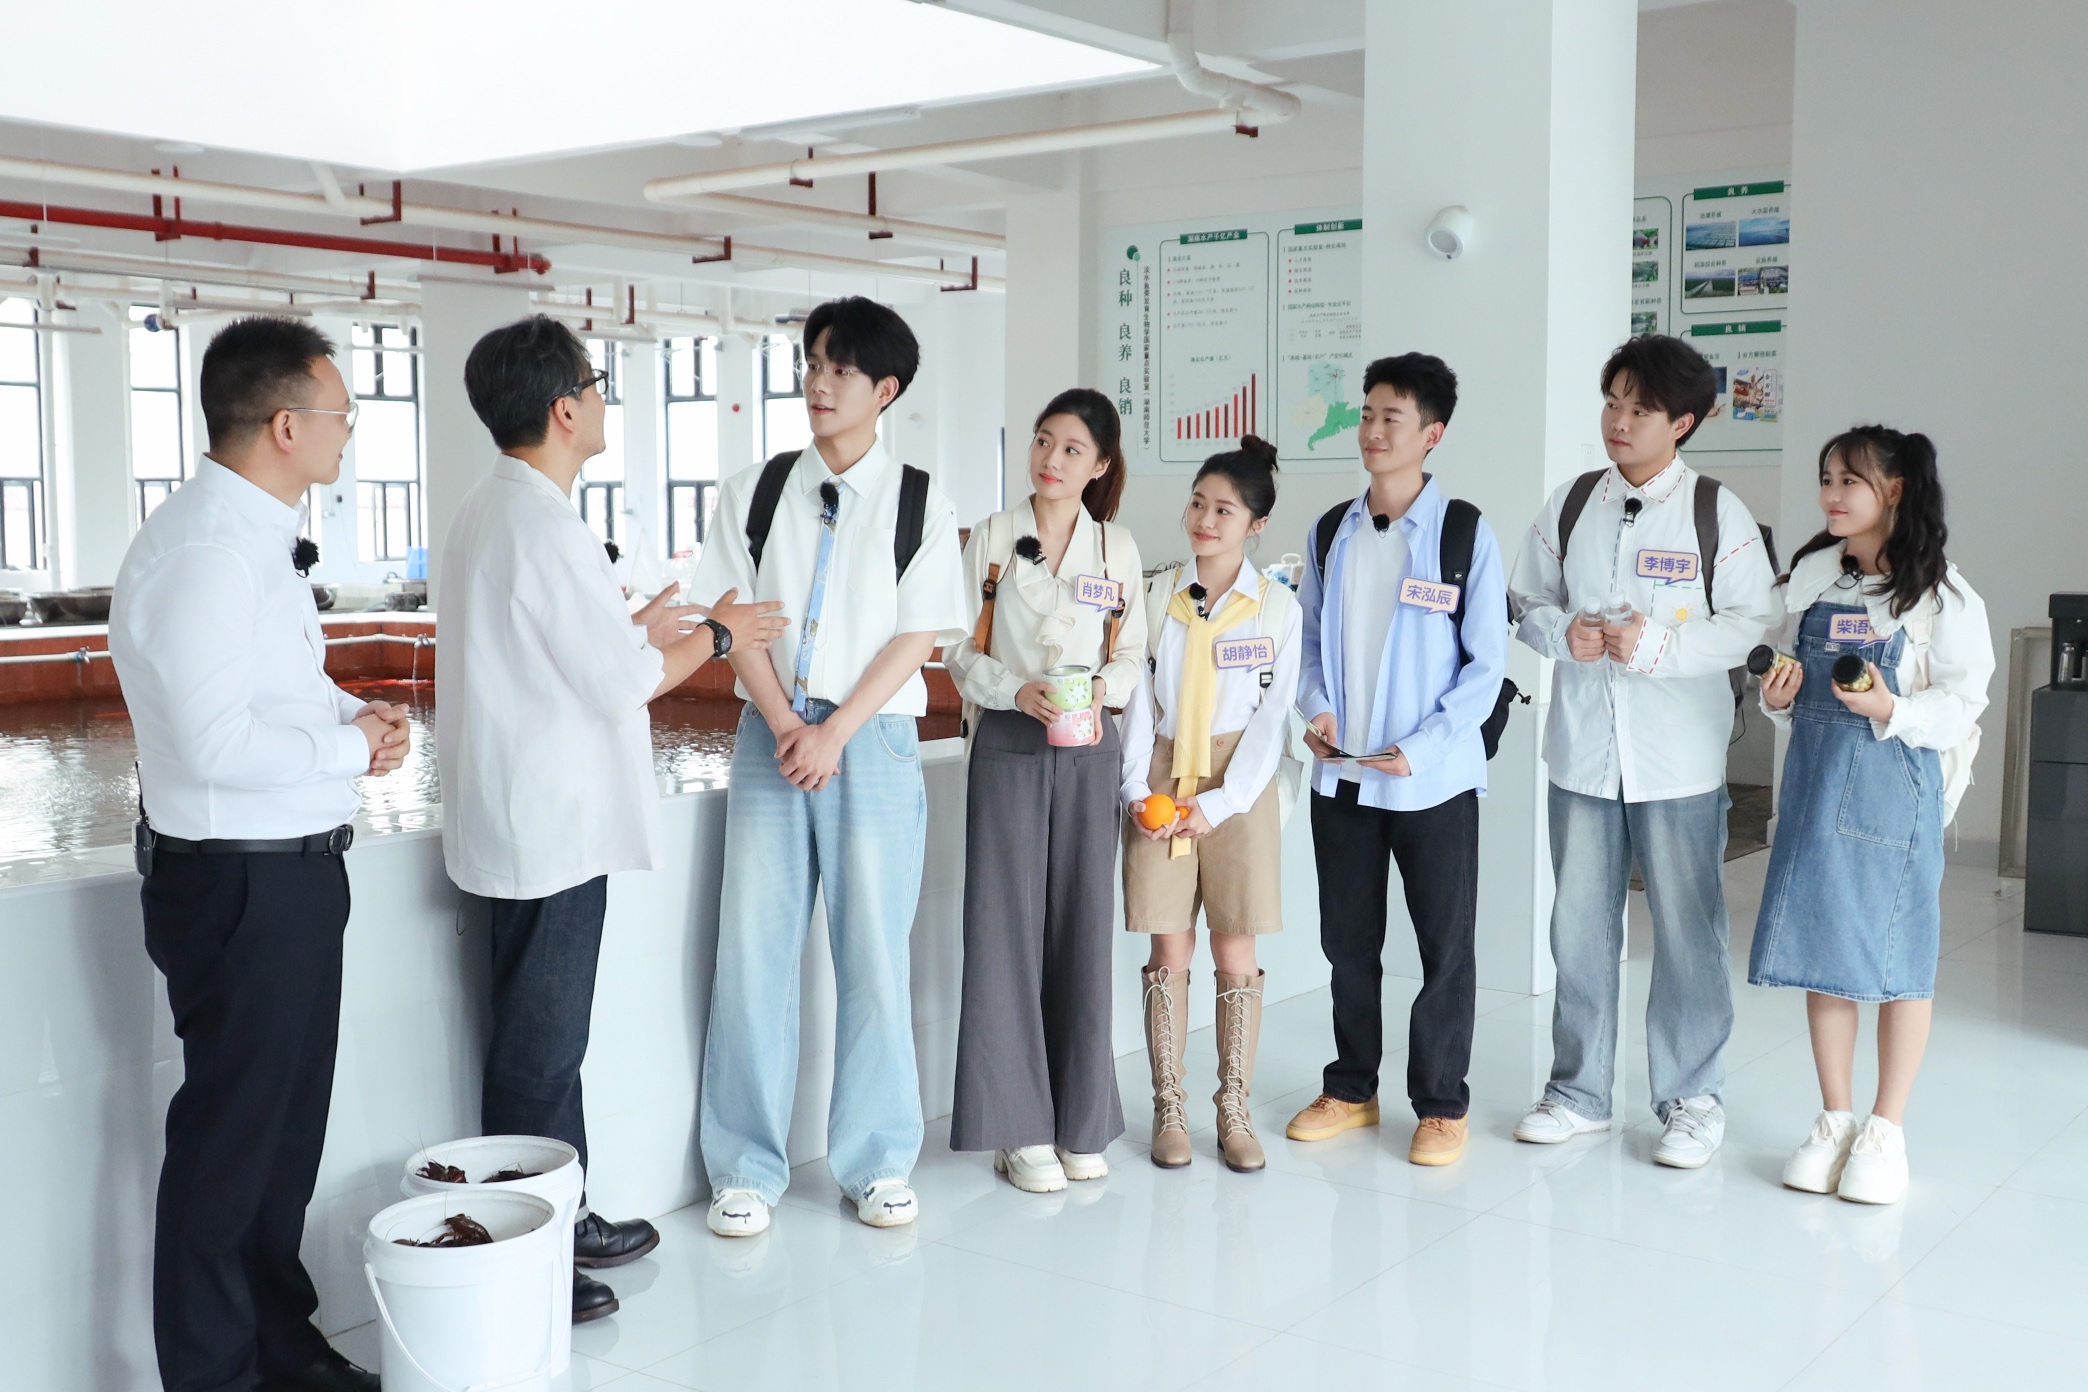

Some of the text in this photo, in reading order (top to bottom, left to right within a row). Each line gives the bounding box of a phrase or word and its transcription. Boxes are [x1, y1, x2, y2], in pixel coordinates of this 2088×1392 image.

[1316, 221, 1345, 232] 体制创新
[1187, 231, 1241, 243] 湖南水产千亿产业
[1118, 268, 1133, 416] 良种 良养 良销
[1643, 556, 1691, 573] 李博宇
[1082, 581, 1115, 602] 肖梦凡
[1406, 584, 1453, 606] 宋泓辰
[1836, 619, 1875, 635] 柴语
[1222, 643, 1268, 662] 胡静怡
